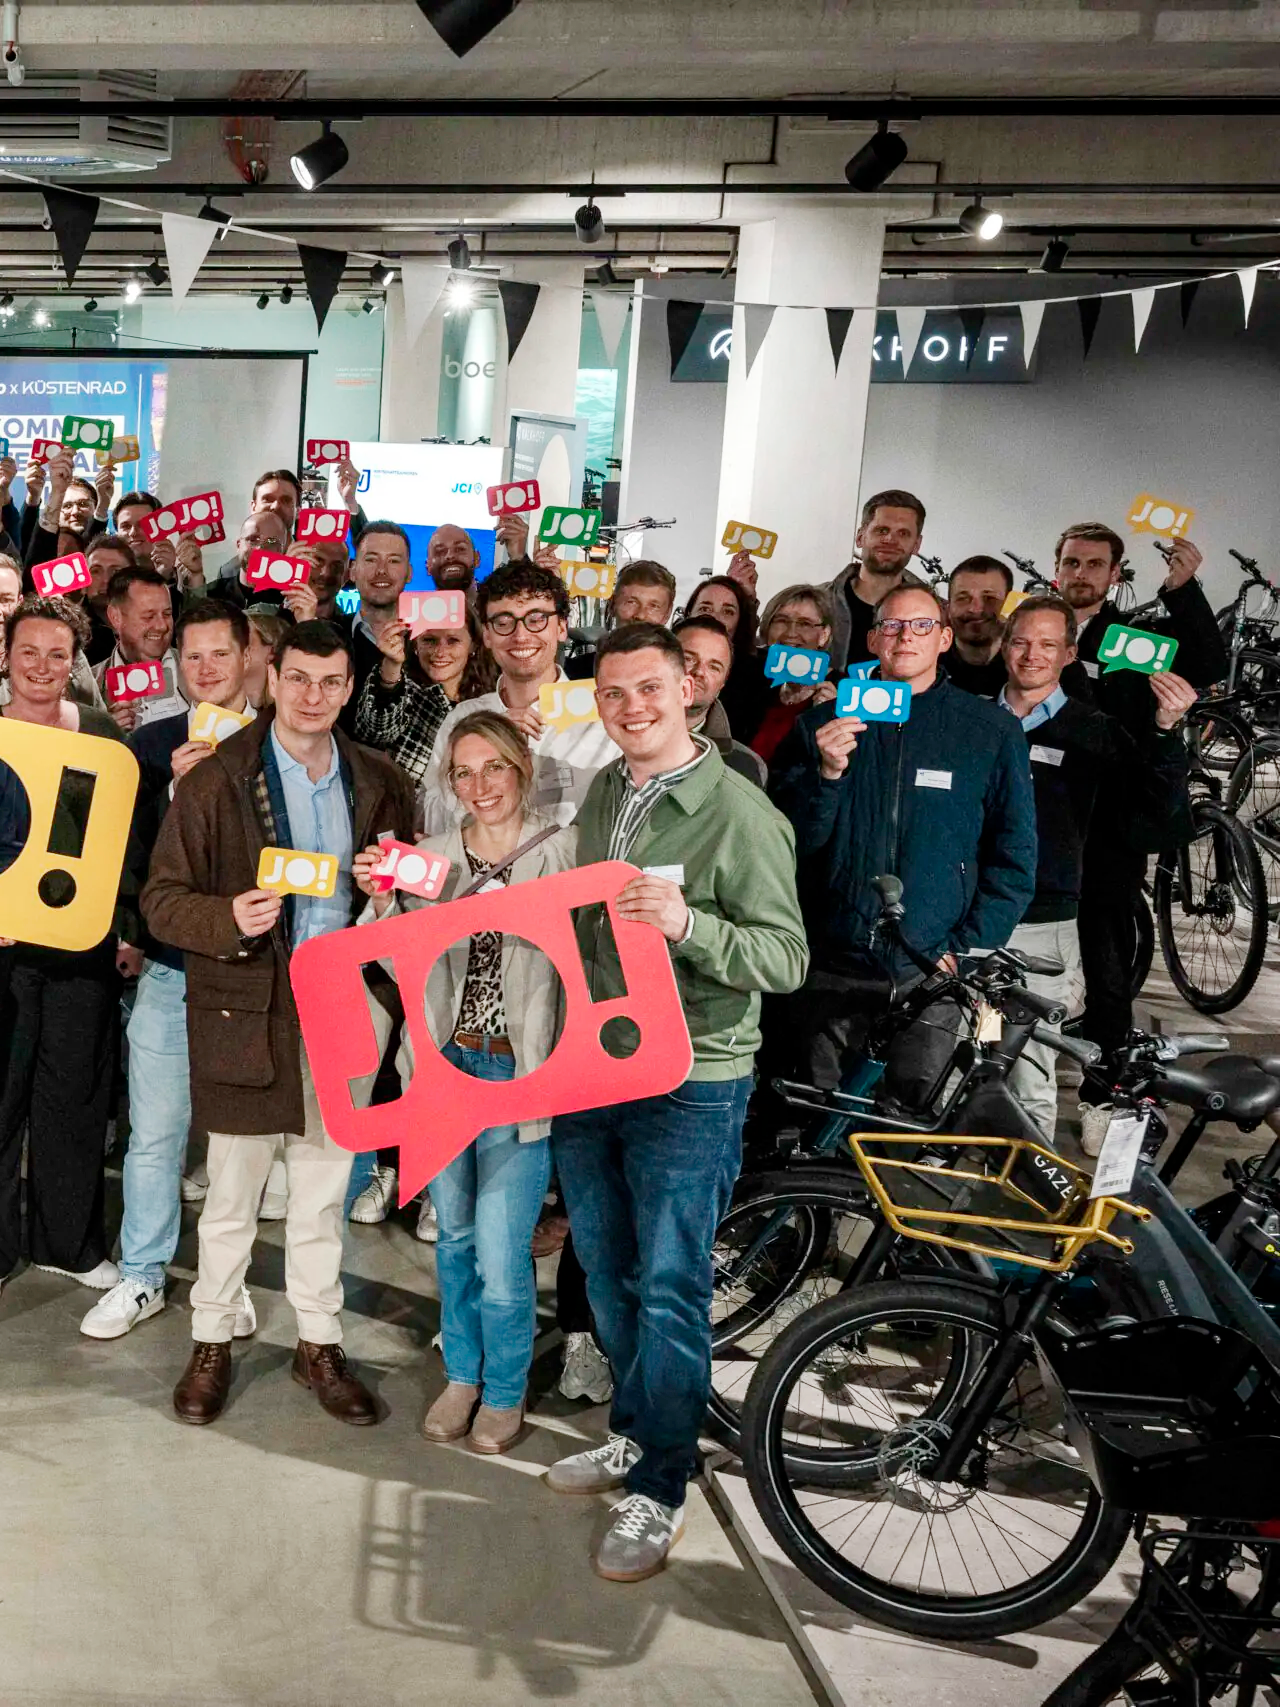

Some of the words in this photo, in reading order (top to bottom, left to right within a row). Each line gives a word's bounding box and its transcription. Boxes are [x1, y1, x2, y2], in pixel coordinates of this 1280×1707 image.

[22, 379, 127, 395] KÜSTENRAD
[65, 421, 110, 447] JO!
[34, 442, 63, 460] JO
[310, 443, 346, 460] JO!
[451, 482, 473, 494] JCI
[492, 484, 535, 512] JO!
[179, 495, 219, 525] JO!
[1131, 501, 1188, 535] JO!
[148, 511, 177, 539] JO
[194, 521, 221, 541] O!
[301, 513, 346, 538] JO!
[542, 512, 596, 541] JO!
[726, 527, 772, 554] JO!
[41, 558, 86, 594] JO!
[251, 556, 304, 583] JO!
[405, 596, 459, 623] JO!
[1104, 632, 1171, 670] JO!
[113, 665, 160, 696] JO!
[770, 651, 823, 681] JO!
[547, 687, 595, 720] JO
[842, 686, 904, 716] JO!
[195, 711, 242, 743] JO
[263, 855, 330, 891] JO!
[376, 848, 443, 891] JO!
[346, 901, 643, 1111] JO!
[1034, 1154, 1081, 1201] GAZE
[1156, 1279, 1174, 1305] RIESE
